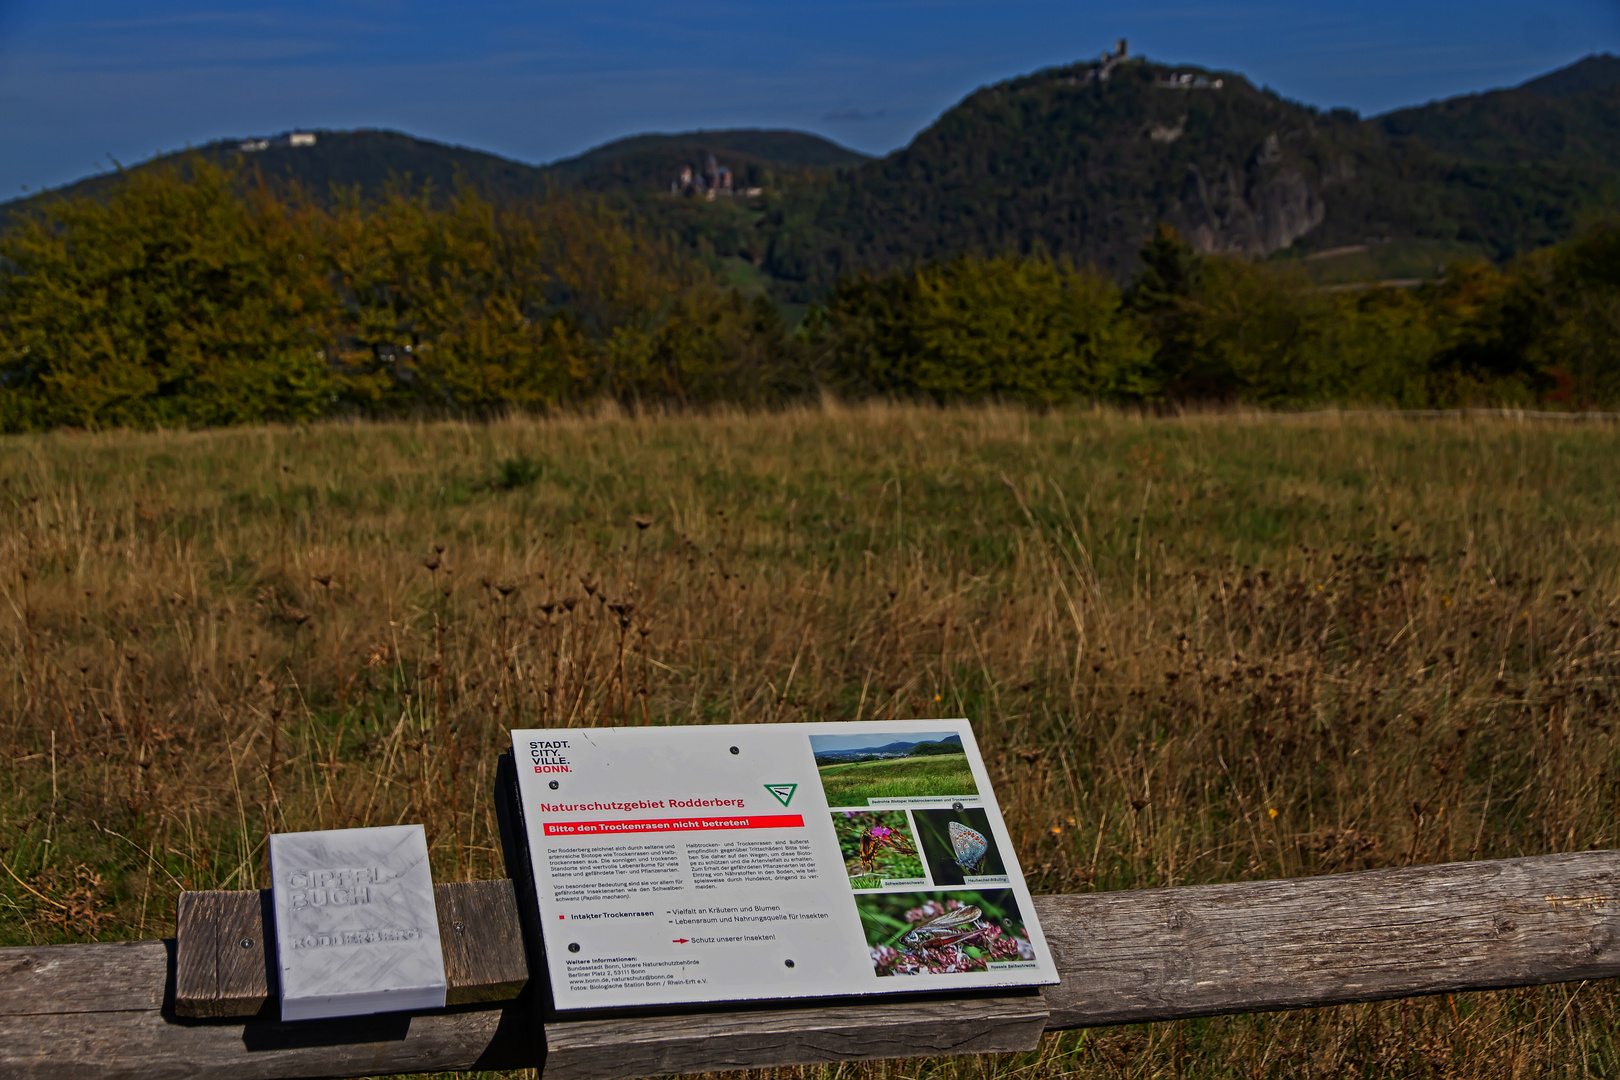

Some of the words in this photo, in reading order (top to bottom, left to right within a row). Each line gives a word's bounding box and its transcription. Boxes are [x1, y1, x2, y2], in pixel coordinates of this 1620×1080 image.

[541, 800, 665, 812] Naturschutzgebiet
[669, 798, 745, 808] Rodderberg
[599, 822, 670, 831] Trockenrasen
[292, 886, 370, 909] BUCH
